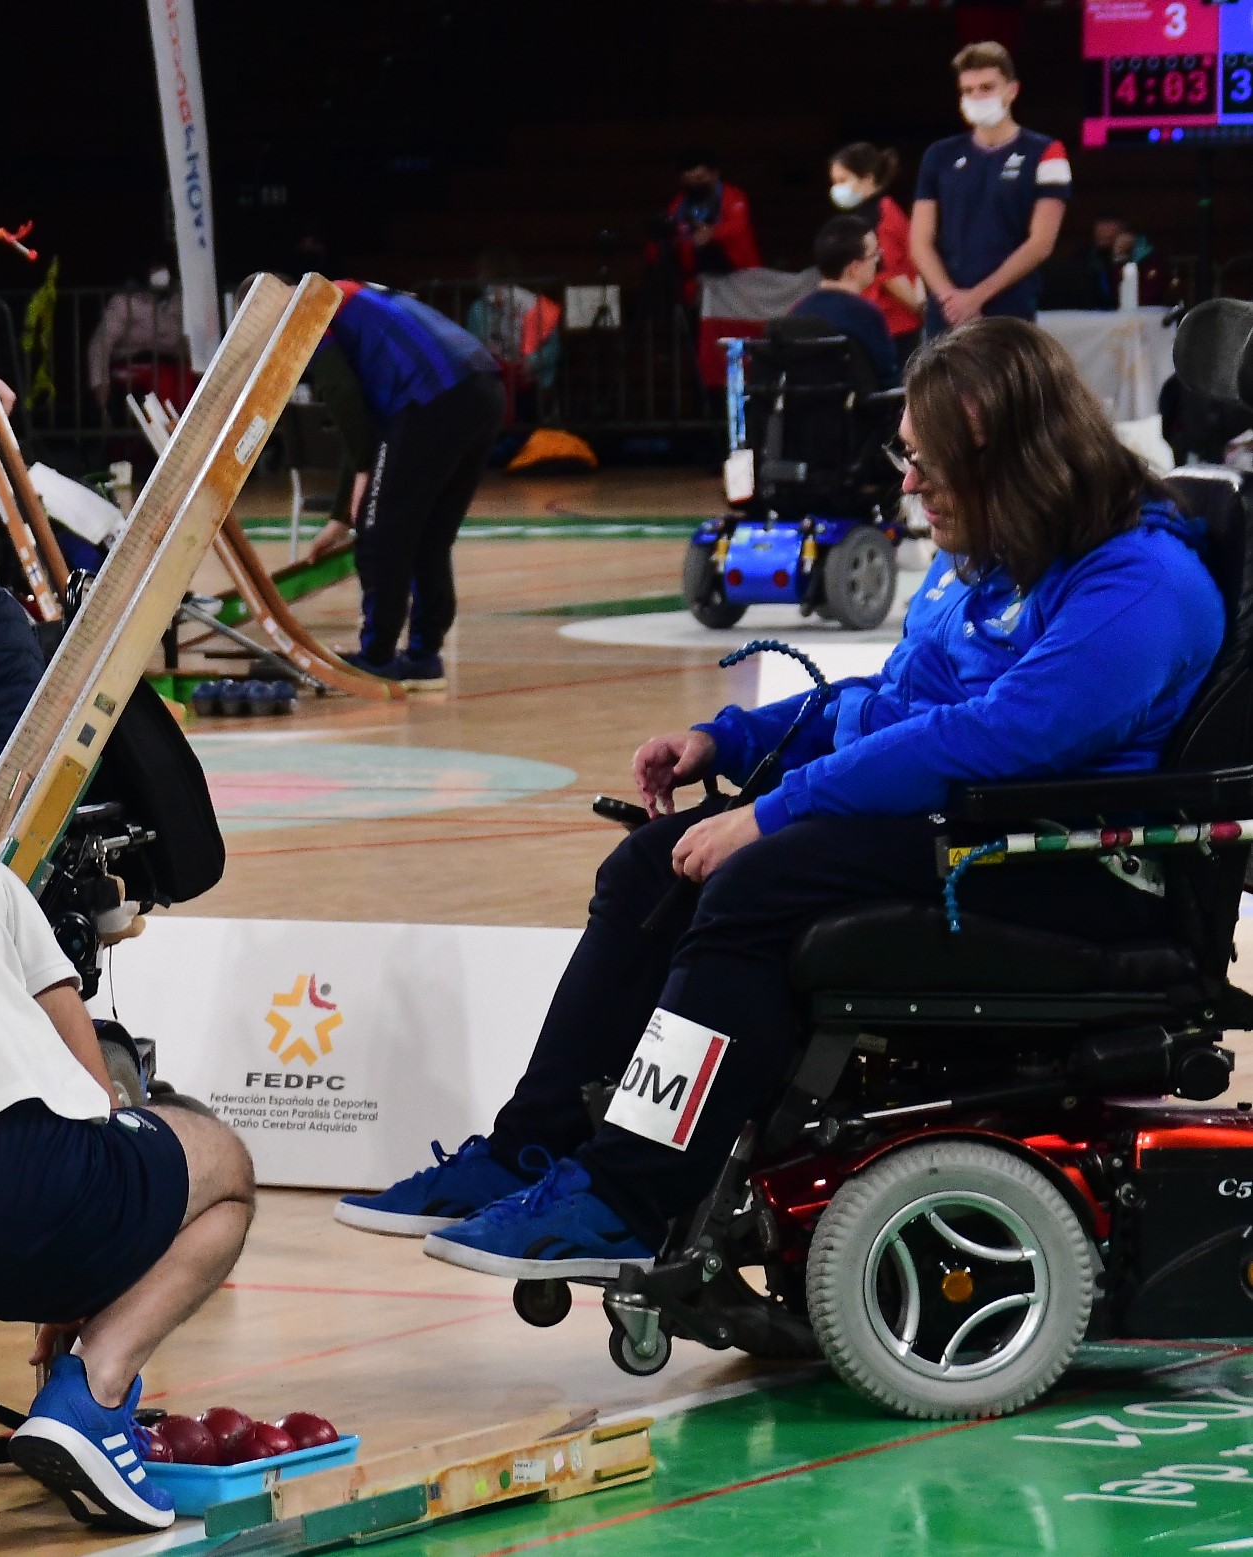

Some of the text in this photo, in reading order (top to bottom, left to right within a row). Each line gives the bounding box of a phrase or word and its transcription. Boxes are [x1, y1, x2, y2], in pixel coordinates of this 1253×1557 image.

[1164, 3, 1187, 38] 3
[1115, 70, 1208, 105] 4:03
[246, 1072, 345, 1090] FEDPC
[210, 1093, 378, 1110] Federación Española de Deportes
[223, 1106, 267, 1117] Personas
[270, 1109, 289, 1117] con
[292, 1107, 330, 1119] Parálisis
[334, 1110, 379, 1121] Cerebral
[233, 1118, 259, 1128] Daño
[262, 1119, 306, 1130] Cerebral
[309, 1121, 358, 1133] Adquirido
